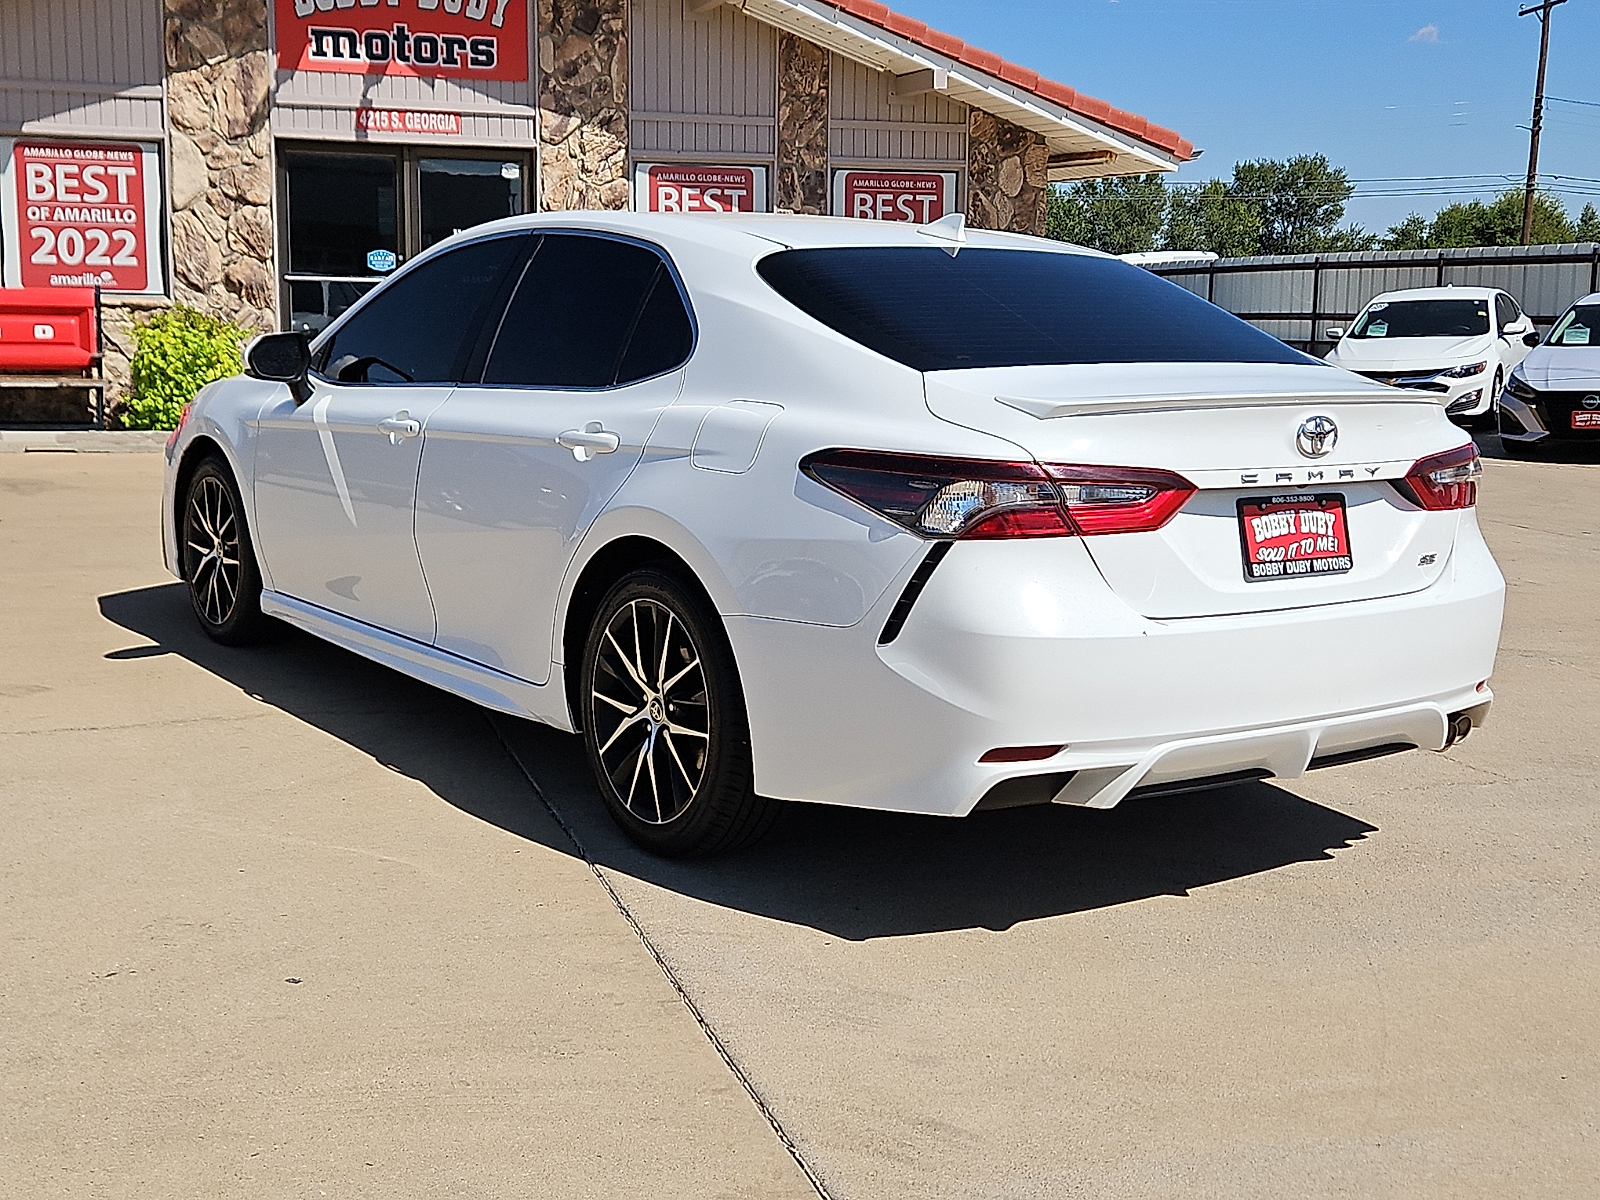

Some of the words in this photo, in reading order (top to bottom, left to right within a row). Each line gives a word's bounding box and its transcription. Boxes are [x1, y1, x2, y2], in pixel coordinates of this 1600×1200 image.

[308, 23, 498, 69] motors
[360, 110, 388, 127] 4215
[391, 111, 403, 128] S.
[405, 111, 457, 131] GEORGIA
[24, 147, 72, 159] AMARILLO
[74, 149, 134, 161] GLOBE-NEWS
[25, 162, 137, 204] BEST
[657, 173, 696, 181] AMARILLO
[697, 174, 745, 183] GLOBE-NEWS
[853, 179, 890, 188] AMARILLO
[658, 186, 747, 212] BEST
[854, 193, 937, 224] BEST
[27, 206, 50, 221] OF
[53, 207, 137, 223] AMARILLO
[30, 227, 139, 267] 2022
[50, 272, 102, 286] amarillo
[1251, 510, 1297, 543] BOBBY
[1299, 510, 1335, 536] DUBY
[1256, 547, 1285, 561] SOLD
[1287, 543, 1299, 560] IT
[1300, 538, 1315, 556] TO
[1252, 562, 1284, 577] BOBBY
[1286, 559, 1312, 574] DUBY
[1313, 556, 1351, 571] MOTORS
